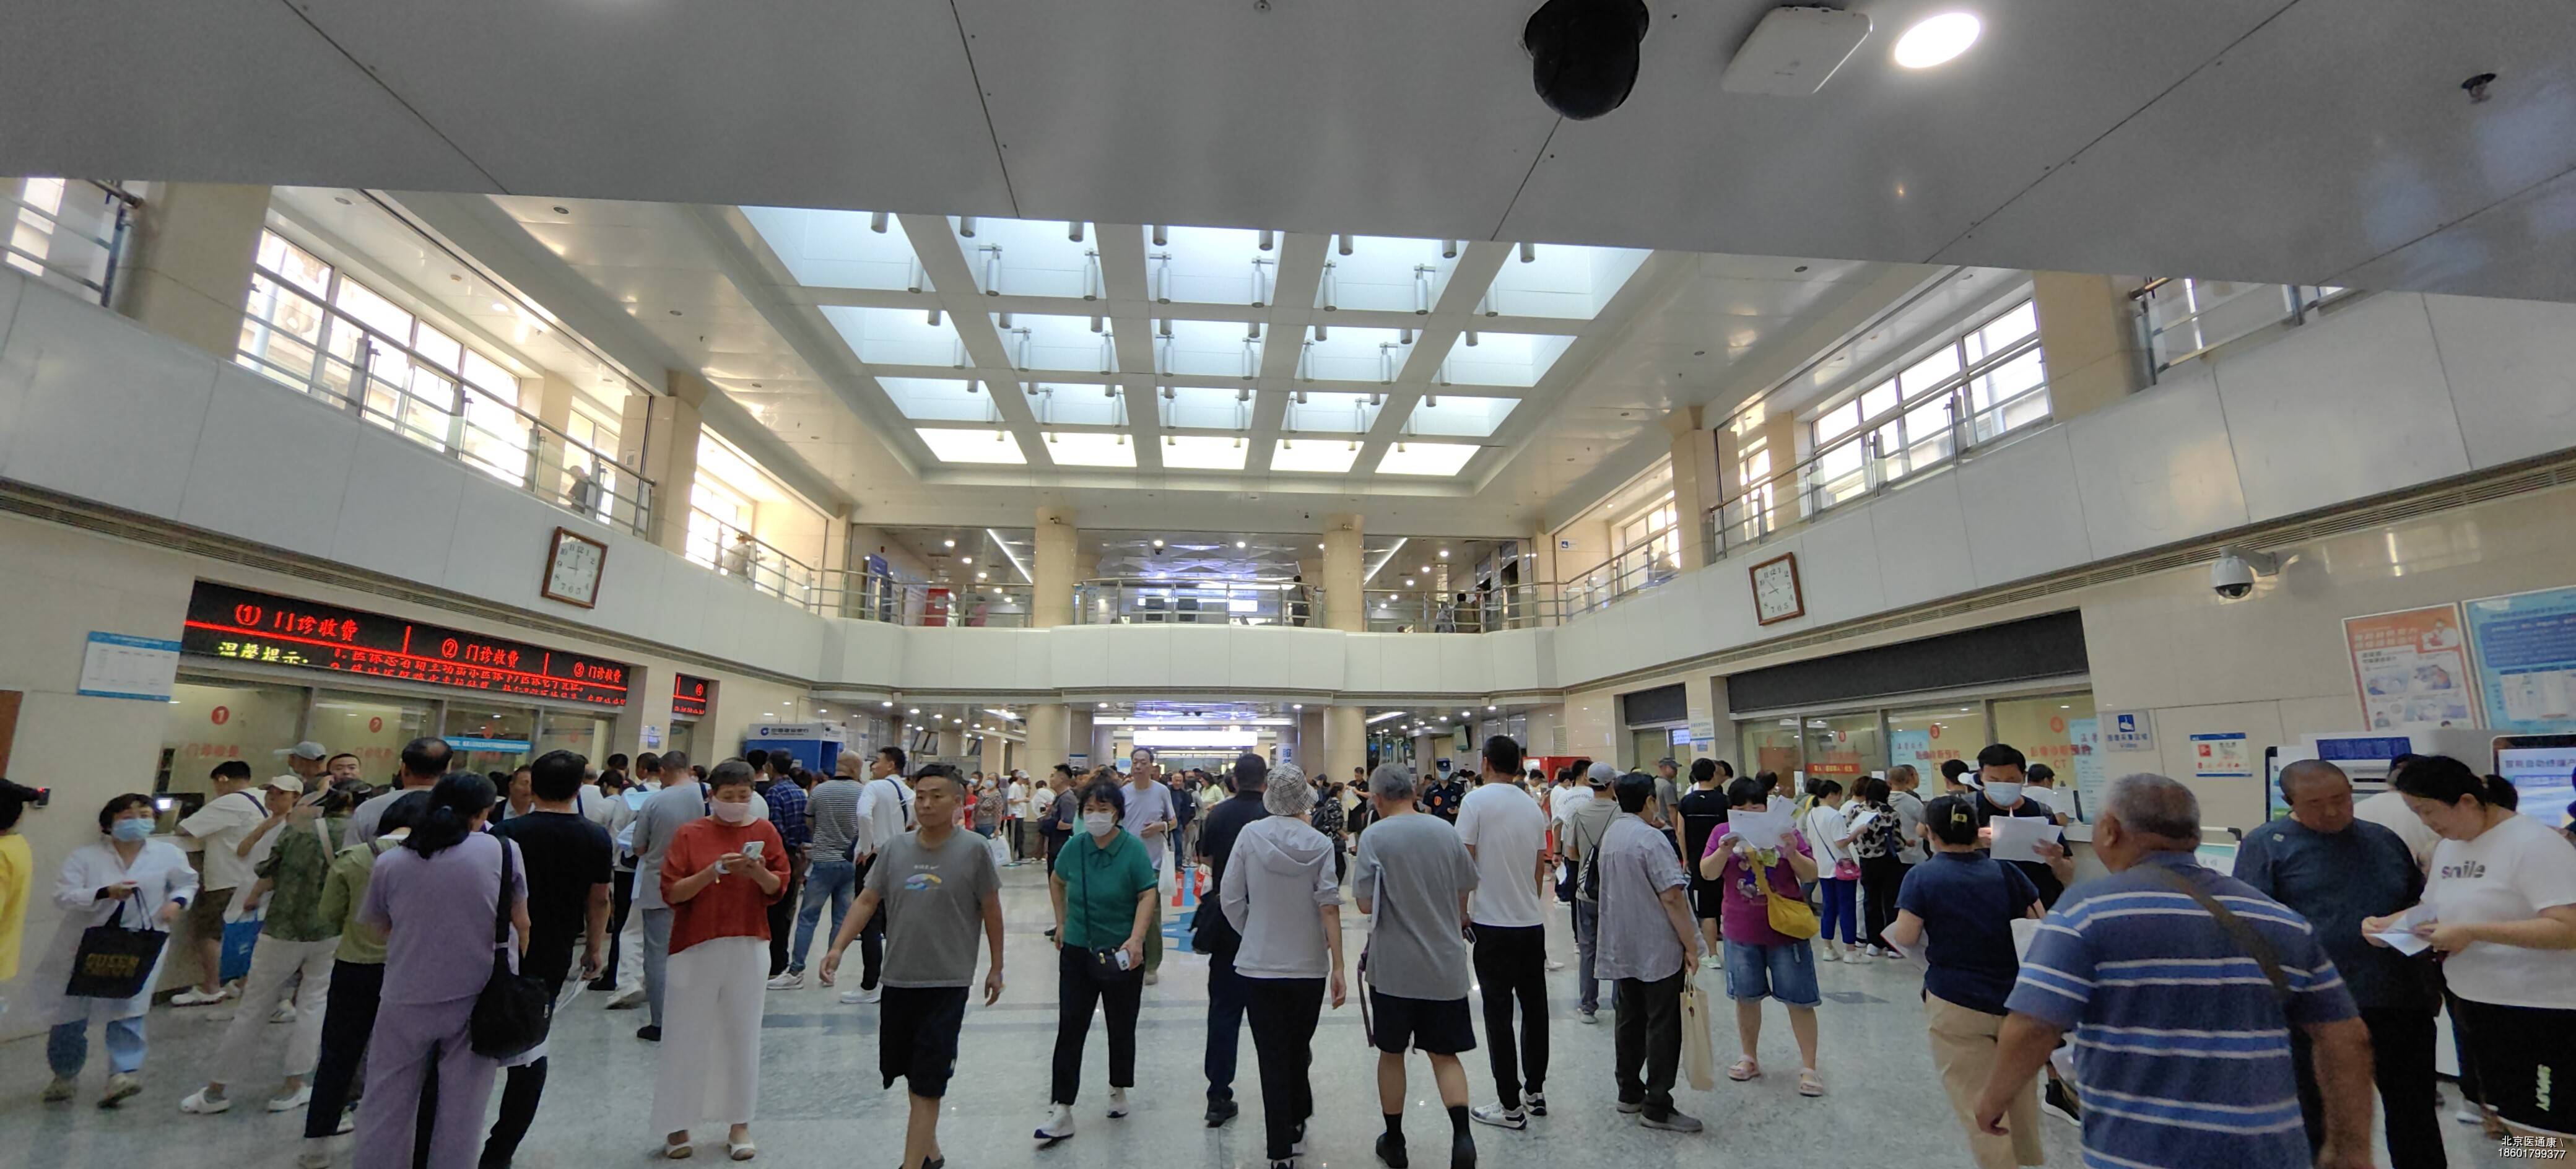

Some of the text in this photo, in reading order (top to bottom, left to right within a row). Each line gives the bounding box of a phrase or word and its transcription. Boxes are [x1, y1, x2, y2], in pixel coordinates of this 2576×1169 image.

[274, 611, 359, 642] 门诊收费
[466, 644, 519, 668] 门诊收费
[589, 665, 621, 684] 门诊收费
[2442, 860, 2486, 879] smile
